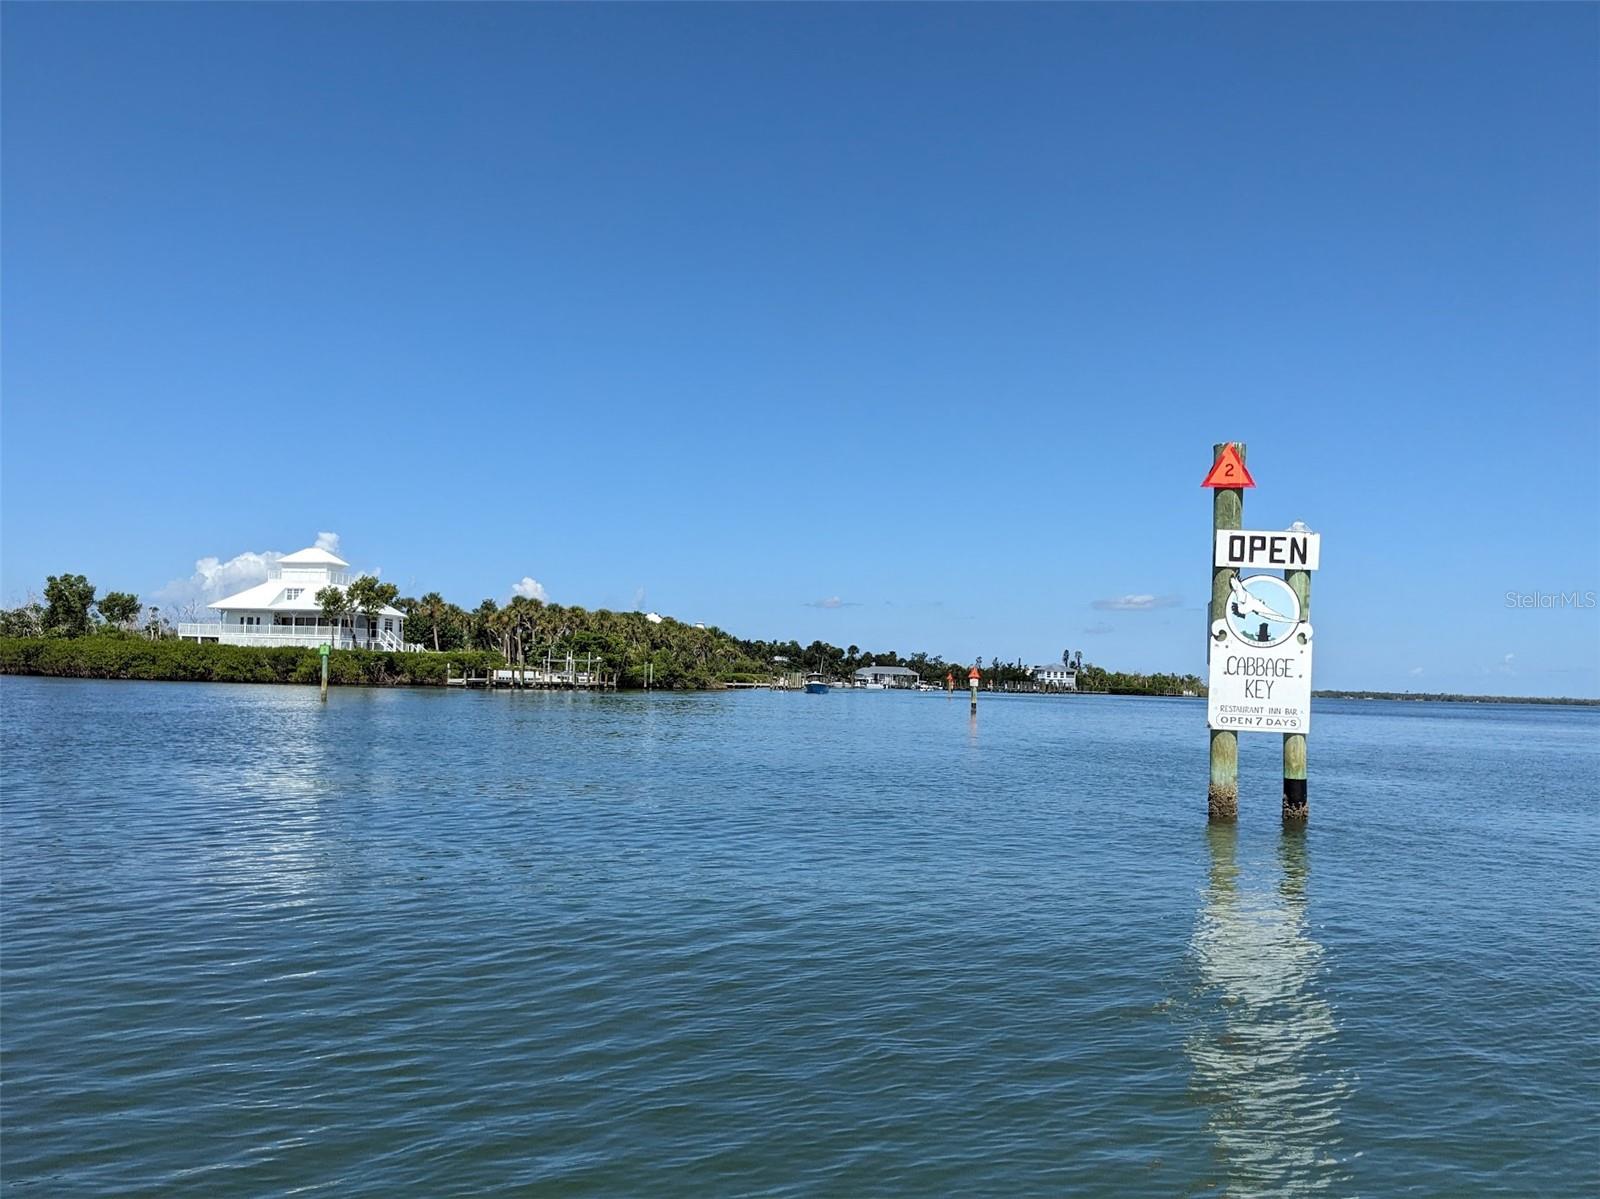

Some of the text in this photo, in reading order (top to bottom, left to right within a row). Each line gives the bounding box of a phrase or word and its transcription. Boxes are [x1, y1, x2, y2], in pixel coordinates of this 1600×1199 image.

[1225, 463, 1234, 477] 2
[1228, 535, 1308, 565] OPEN
[1226, 655, 1295, 678] CABBAGE
[1245, 678, 1275, 700] KEY
[1219, 704, 1298, 716] RESTAURANT INN BAR
[1220, 716, 1298, 727] OPEN 7 DAYS
